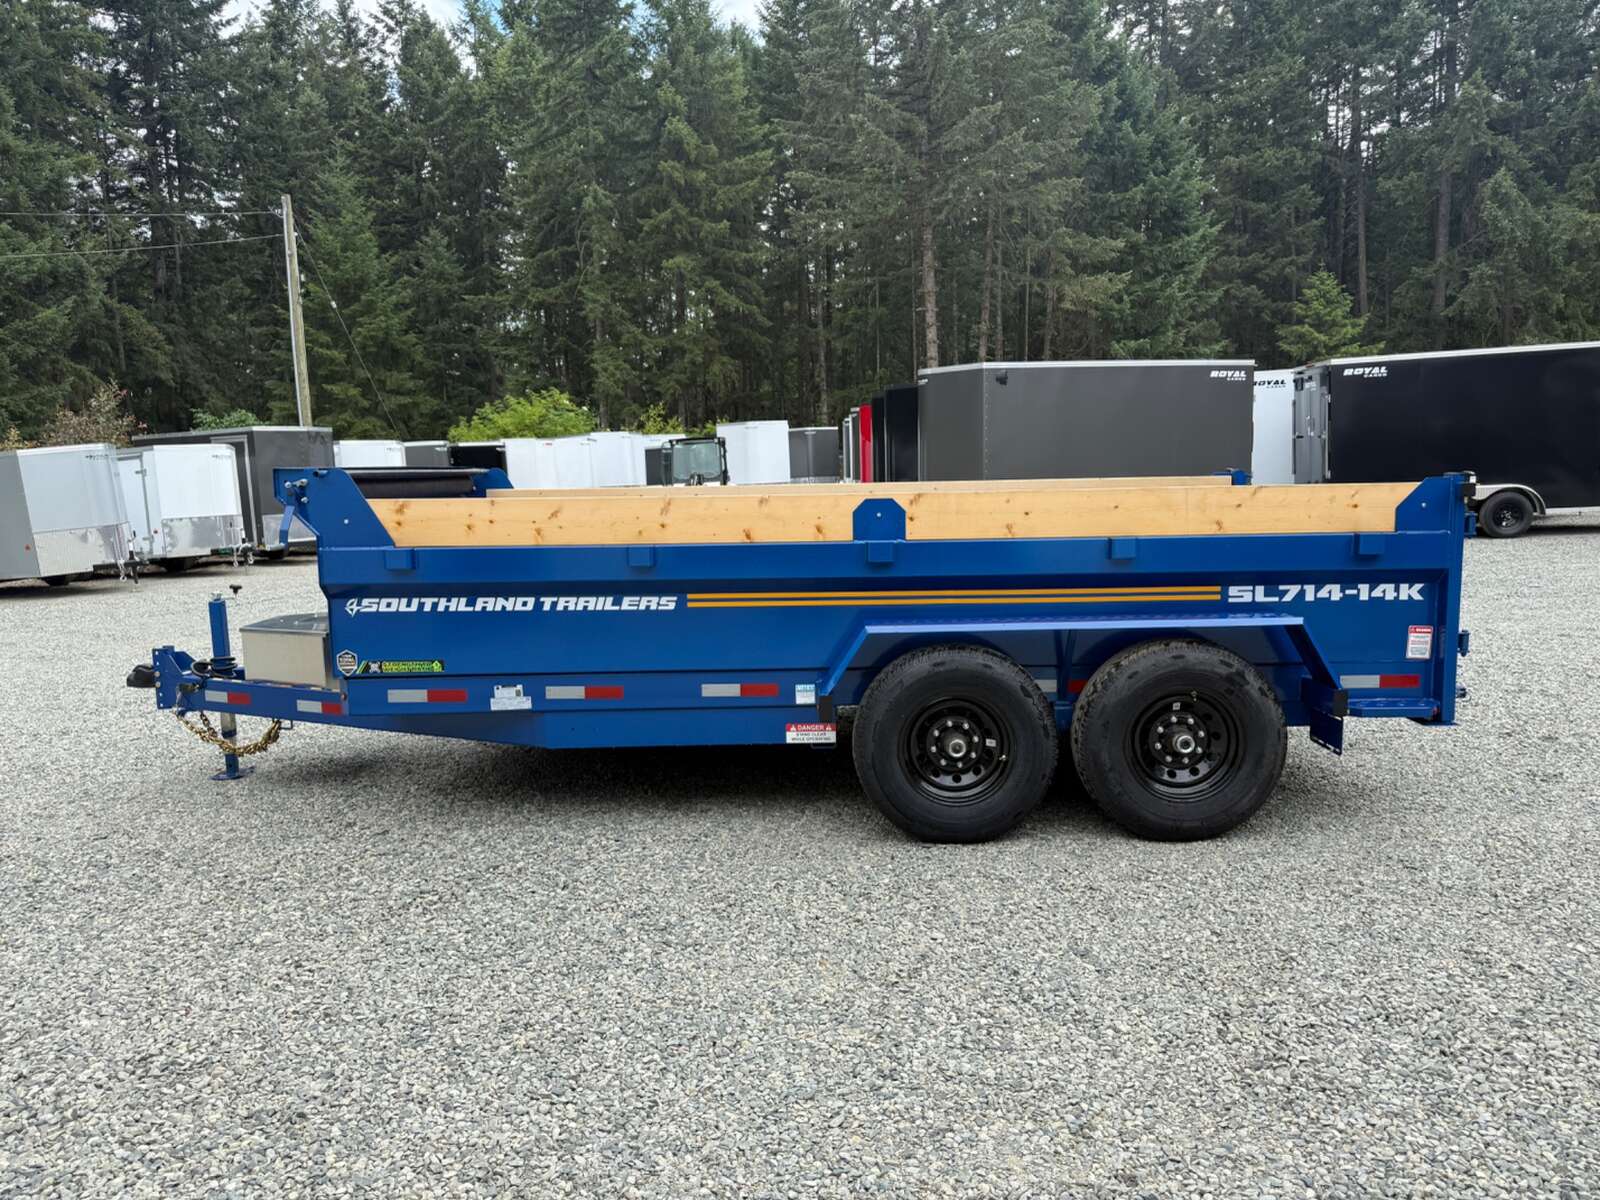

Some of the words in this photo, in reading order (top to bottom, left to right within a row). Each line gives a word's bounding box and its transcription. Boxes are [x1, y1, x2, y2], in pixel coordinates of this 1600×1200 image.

[1210, 370, 1247, 378] ROYAL
[1343, 366, 1388, 376] ROYAL
[1228, 583, 1425, 602] SL714-14K
[359, 597, 535, 612] SOUTHLAND
[540, 596, 677, 611] TRAILERS
